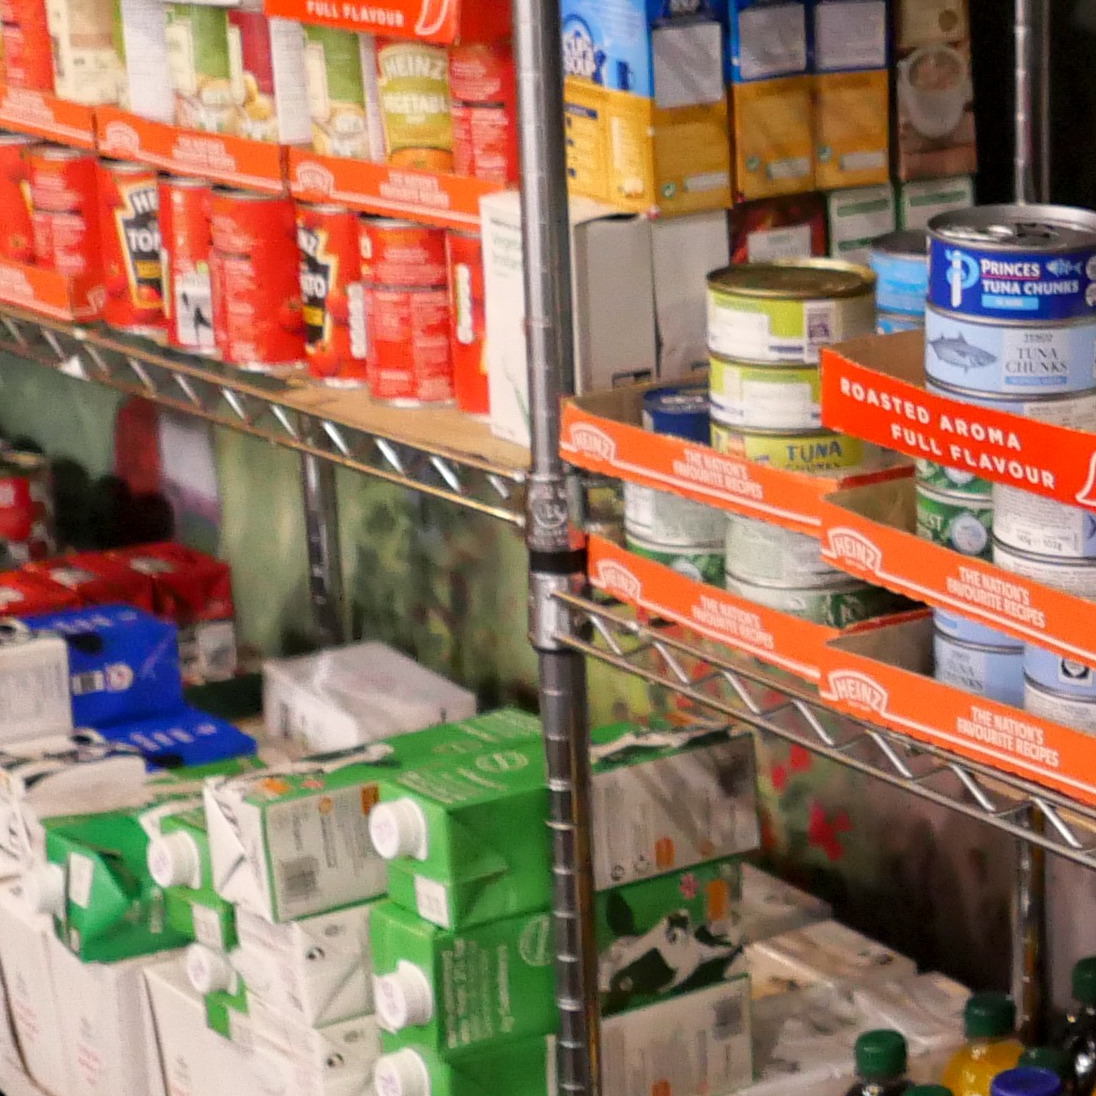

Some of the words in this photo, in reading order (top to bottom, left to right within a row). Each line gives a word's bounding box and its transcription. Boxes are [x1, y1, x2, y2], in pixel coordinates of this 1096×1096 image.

[384, 53, 444, 81] HEINZ
[980, 258, 1041, 278] PRINCES
[982, 280, 1021, 295] TUNA
[1023, 279, 1079, 296] CHUNKS
[1005, 360, 1068, 374] CHUNKS
[1017, 347, 1059, 360] TUNA
[839, 376, 931, 424] ROASTED
[939, 414, 1022, 451] AROMA
[573, 428, 613, 460] HEINZ
[785, 440, 843, 463] TUNA
[890, 423, 943, 456] FULL
[949, 443, 1055, 489] FLAVOUR
[834, 537, 875, 569] HEINZ
[958, 566, 979, 585] THE
[981, 571, 1030, 604] NATION'S
[946, 577, 1004, 610] FAVOURITE
[1004, 595, 1046, 628] RECIPES
[835, 677, 882, 711] HEINZ
[970, 705, 992, 724] THE
[994, 711, 1044, 745] NATION'S
[956, 717, 1014, 751] FAVOURITE
[1015, 734, 1060, 768] RECIPES
